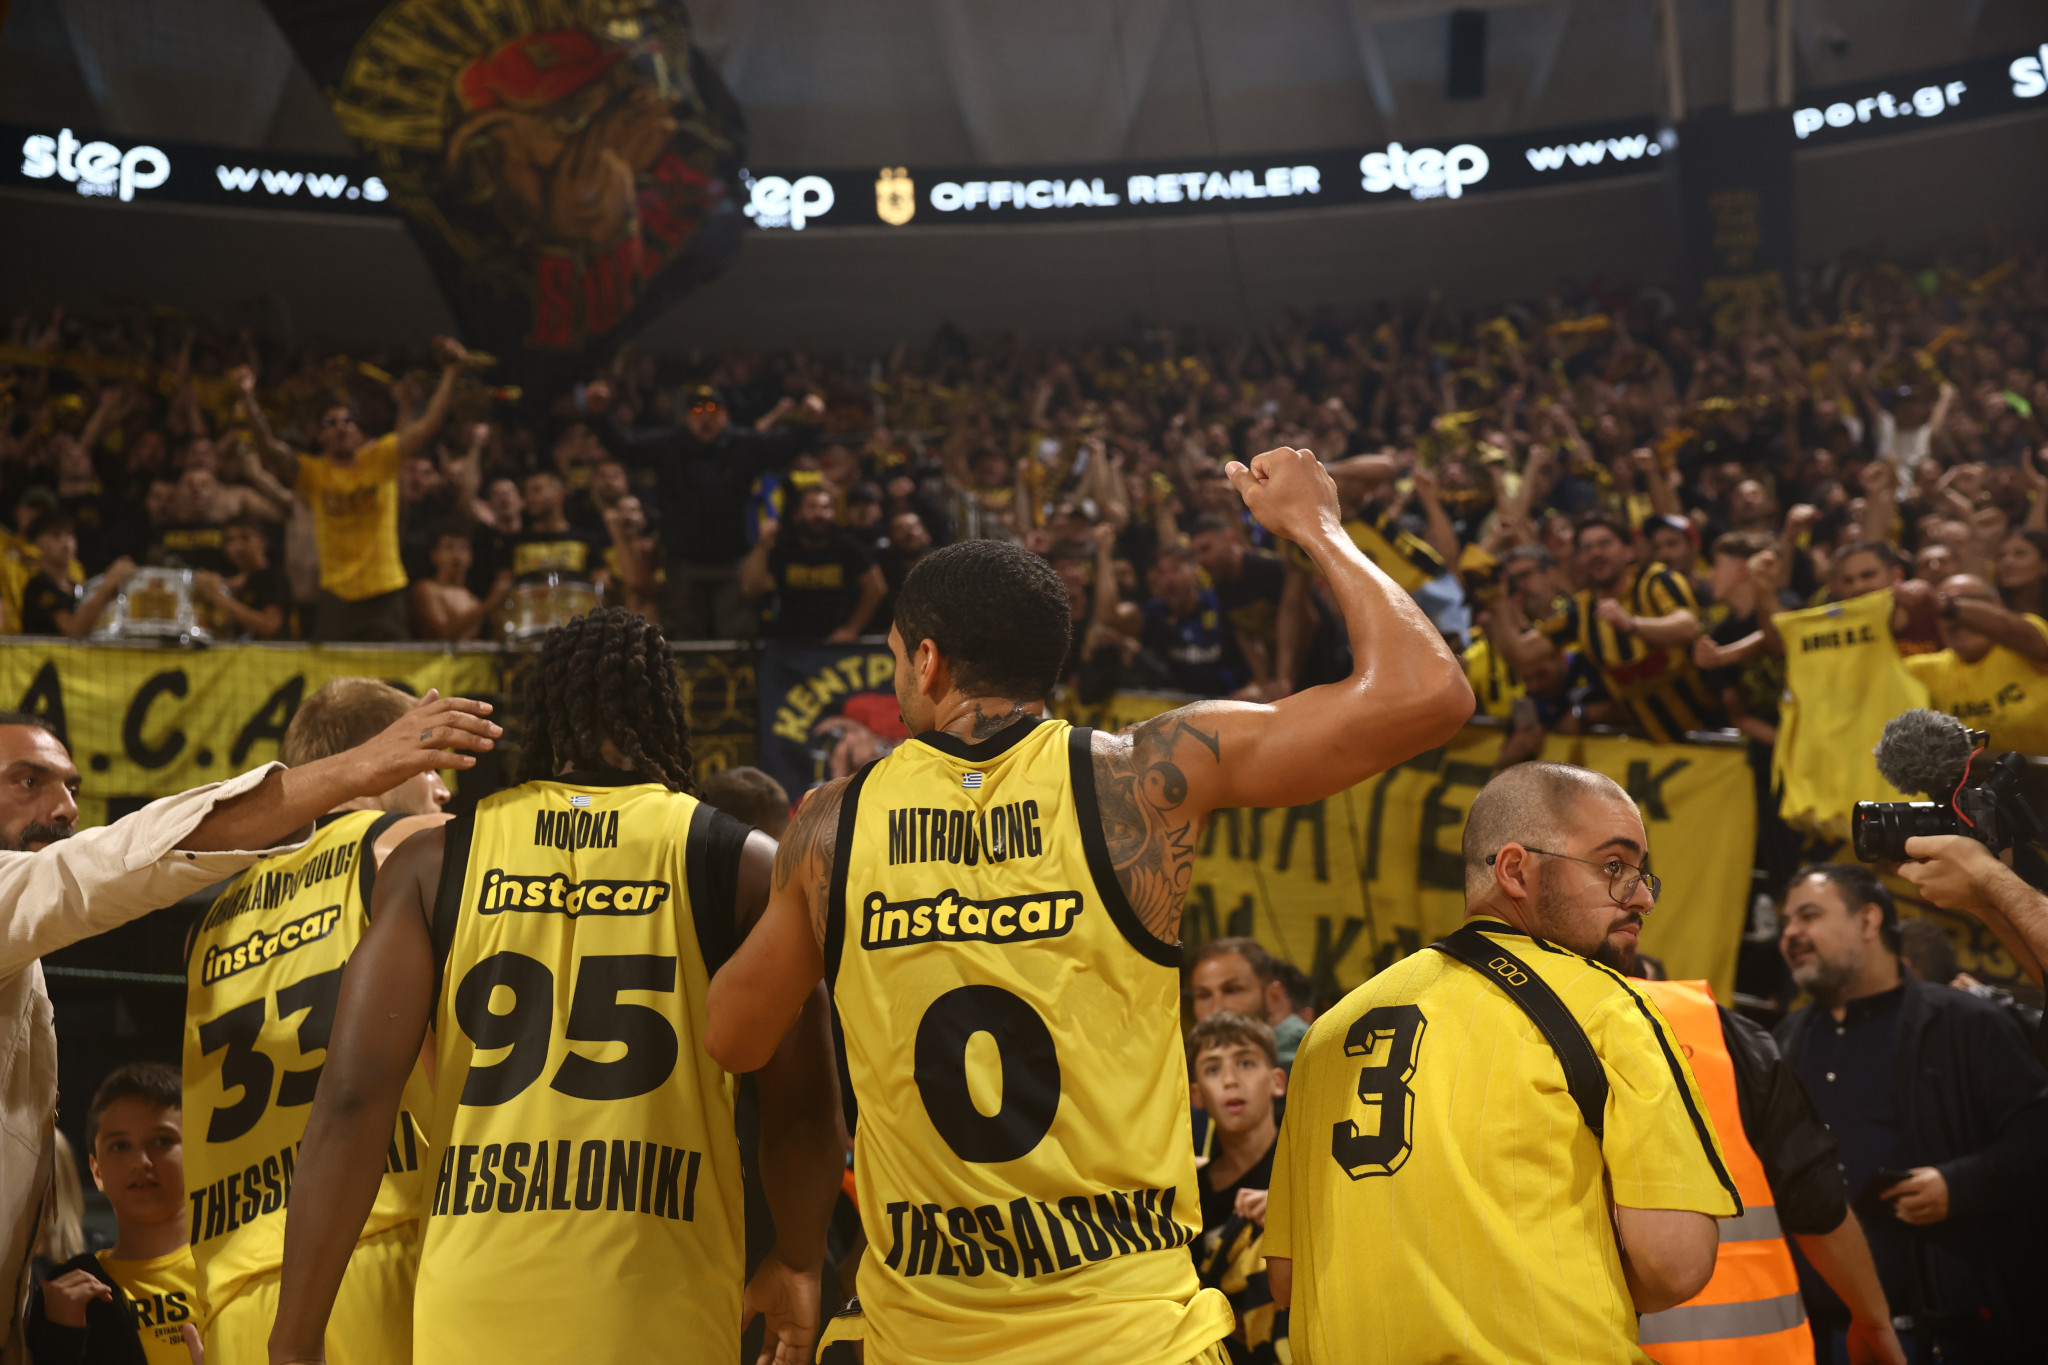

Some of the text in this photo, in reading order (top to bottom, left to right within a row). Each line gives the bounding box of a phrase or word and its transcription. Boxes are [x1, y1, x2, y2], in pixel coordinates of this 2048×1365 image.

[21, 128, 171, 202] step
[738, 168, 835, 231] ep
[930, 165, 1321, 212] OFFICIAL RETAILER
[1359, 141, 1489, 199] step
[482, 871, 667, 915] instacar
[865, 894, 1079, 946] instacar
[203, 906, 340, 985] instacar
[199, 962, 346, 1143] 33
[455, 951, 679, 1106] 95
[914, 984, 1061, 1163] 0
[1332, 1003, 1428, 1181] 3
[432, 1139, 702, 1223] HESSALONIKI
[129, 1292, 190, 1328] RIS
